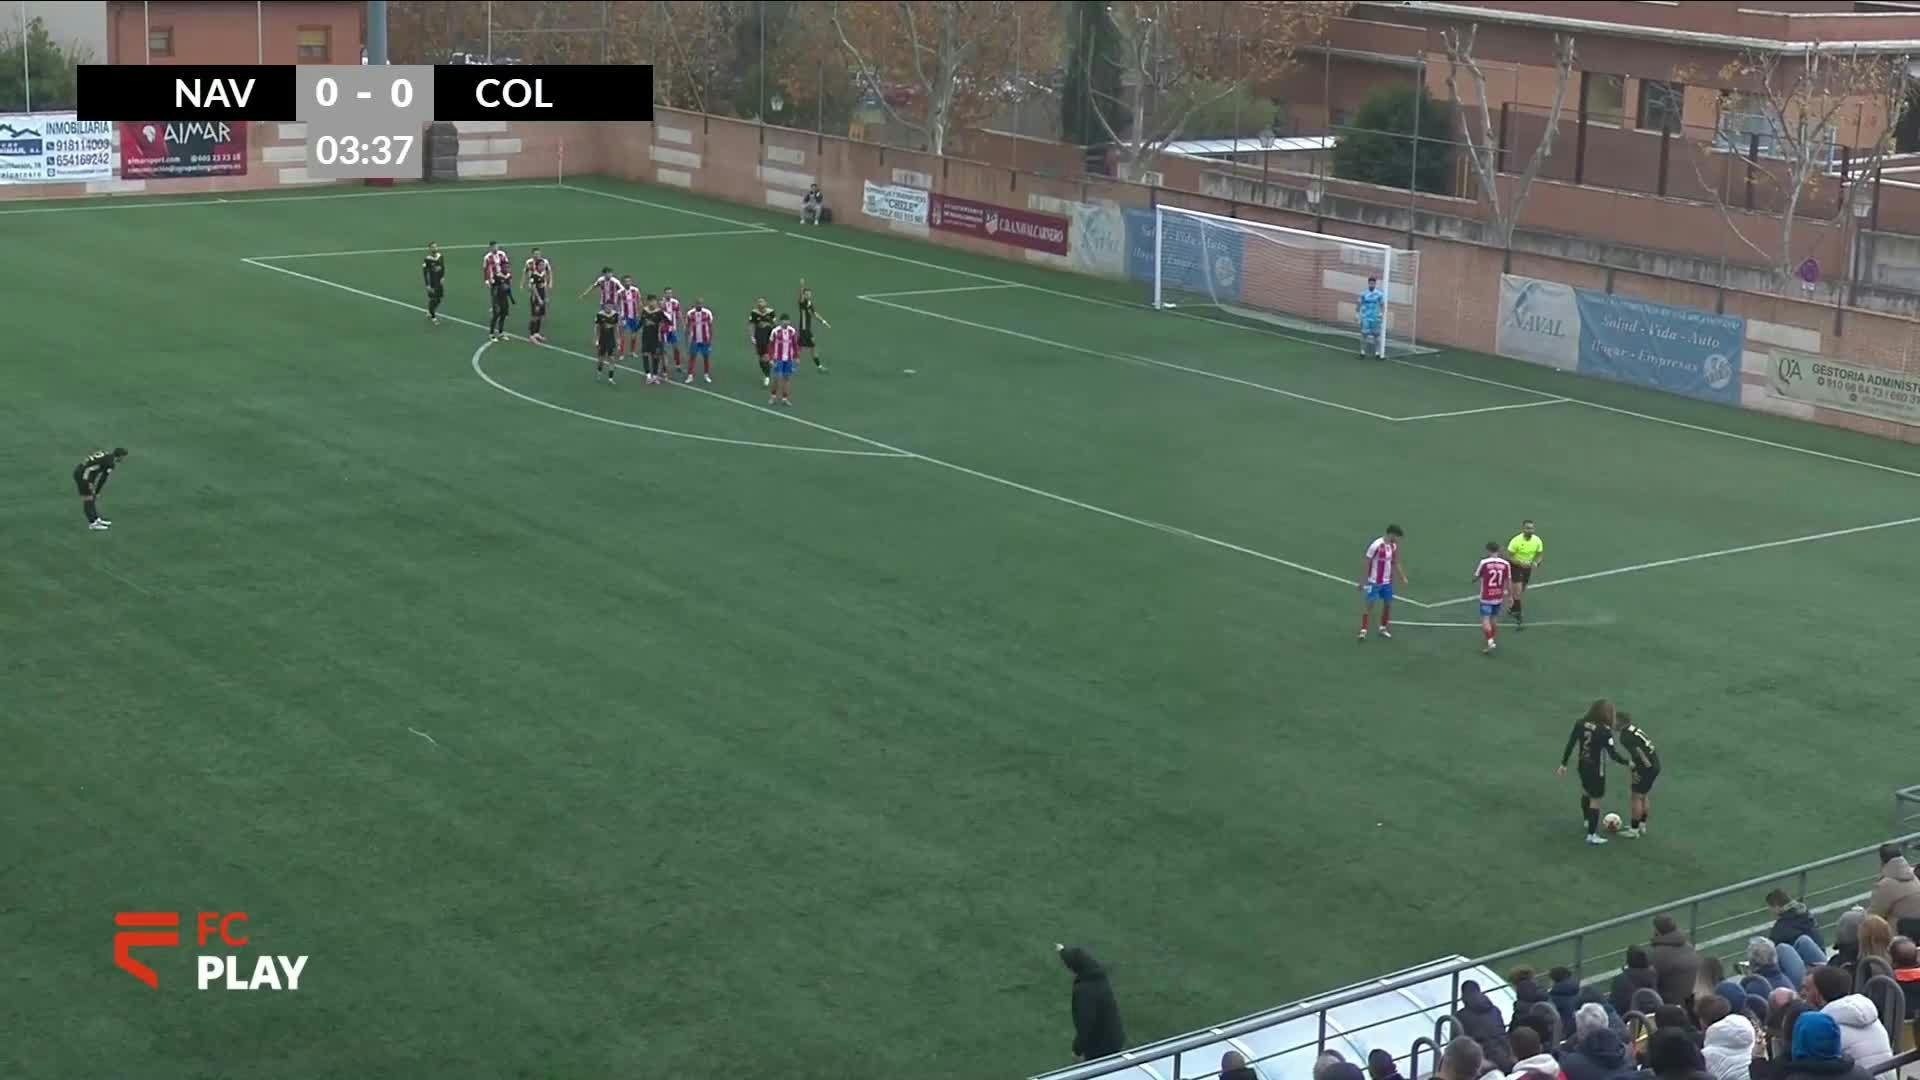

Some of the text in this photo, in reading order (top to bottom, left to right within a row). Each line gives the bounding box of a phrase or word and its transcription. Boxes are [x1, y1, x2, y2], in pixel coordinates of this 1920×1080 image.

[46, 121, 109, 135] INMOBILIARIA
[164, 121, 231, 144] AIMAR
[1648, 322, 1678, 341] Vida
[1687, 330, 1721, 349] Auto
[1638, 349, 1698, 373] Empresas
[1812, 363, 1866, 383] GESTORIA
[1488, 569, 1503, 587] 21
